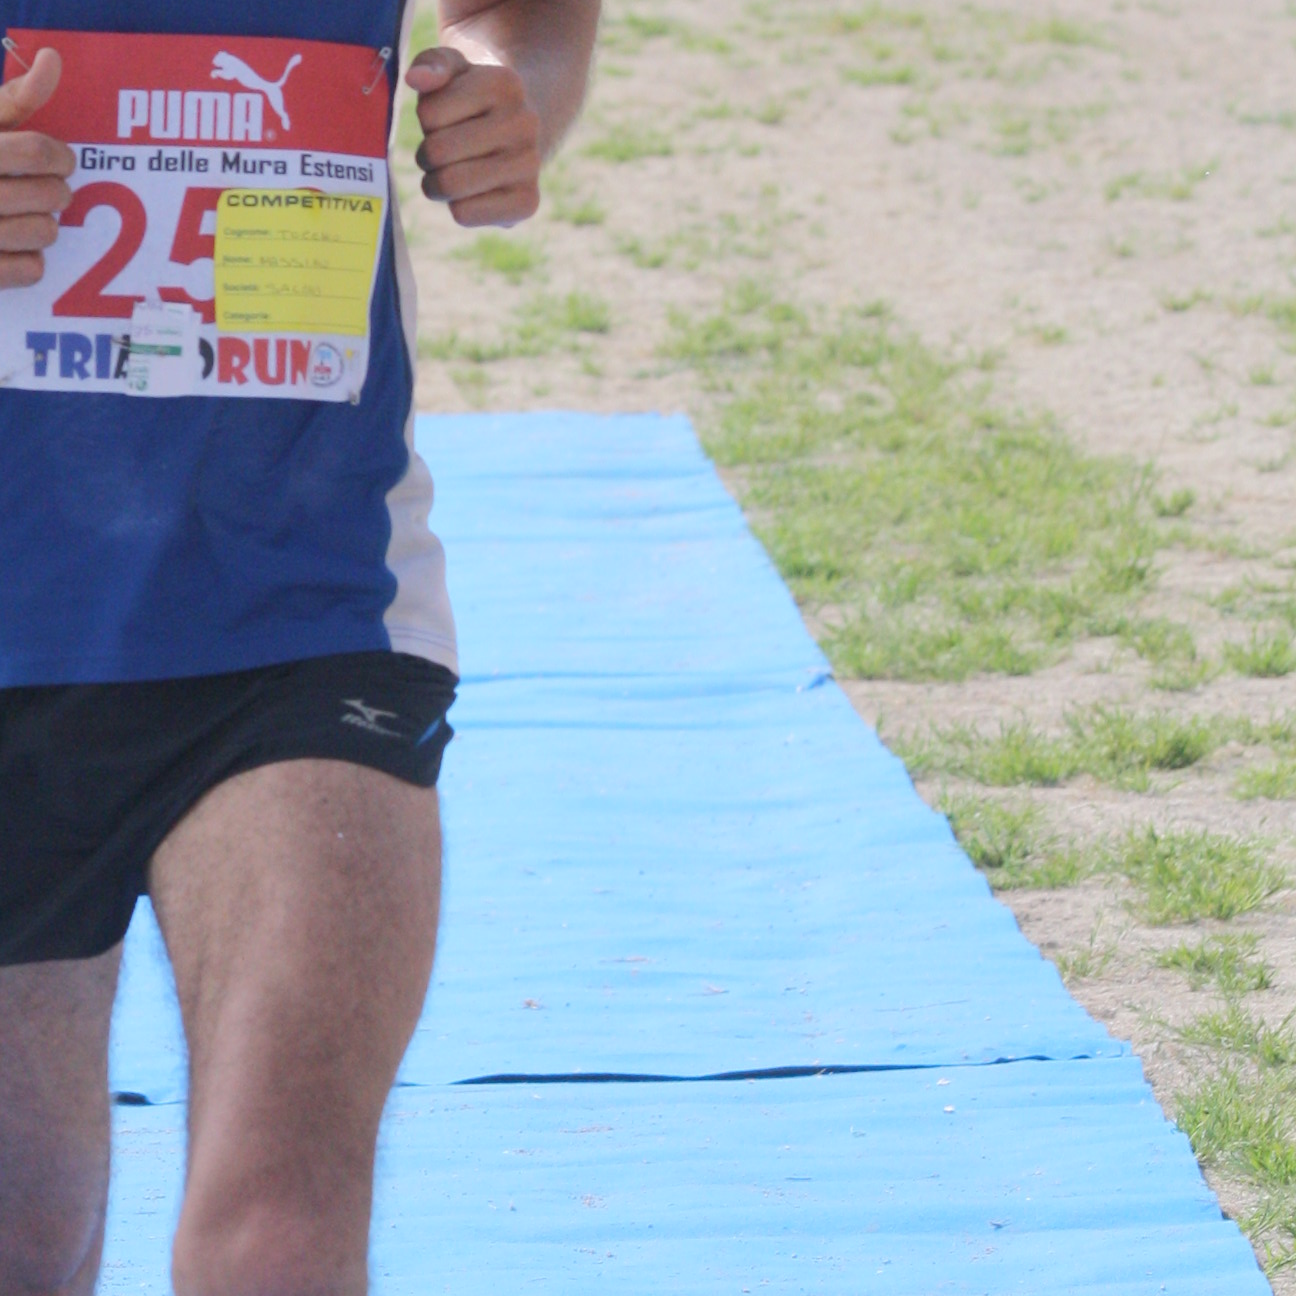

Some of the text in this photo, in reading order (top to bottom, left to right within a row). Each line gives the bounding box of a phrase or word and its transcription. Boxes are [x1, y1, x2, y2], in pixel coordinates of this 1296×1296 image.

[117, 88, 263, 142] PUMA
[81, 147, 375, 183] Giro delle Mura Estensi
[227, 194, 374, 213] COMPETITIVA
